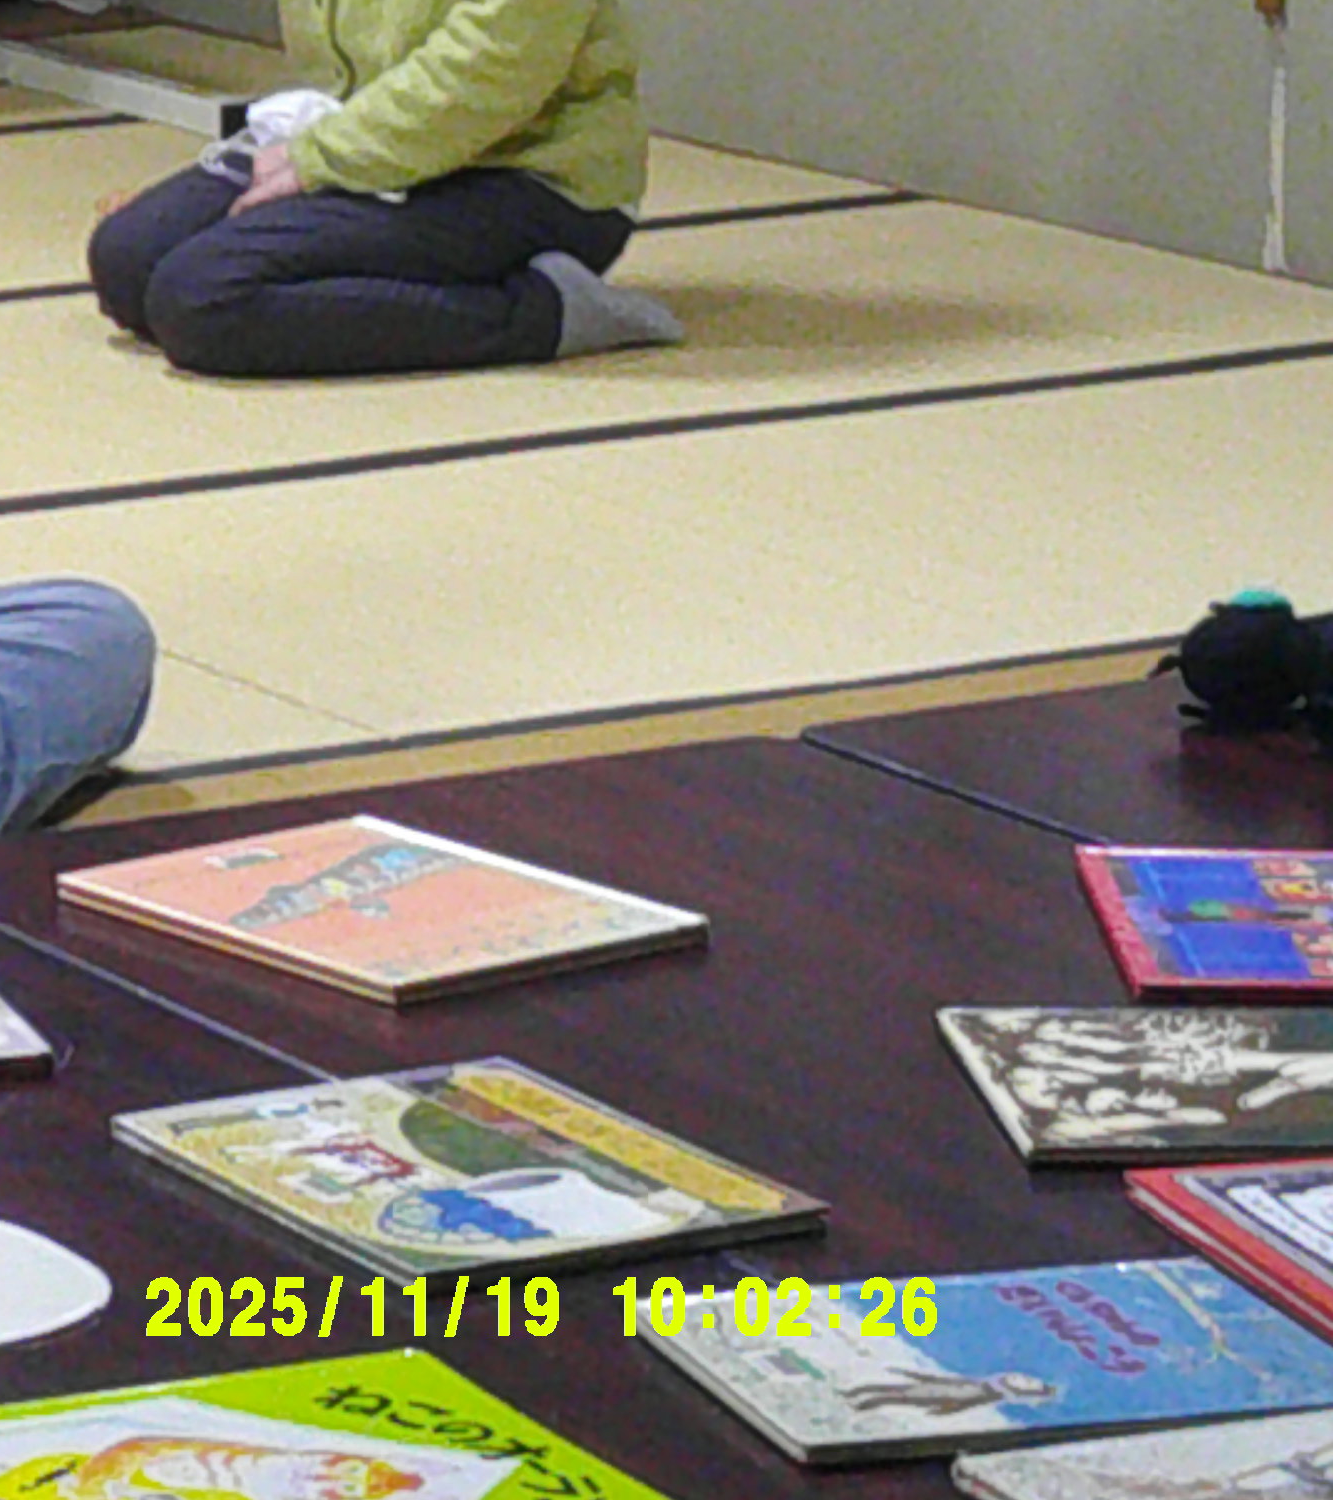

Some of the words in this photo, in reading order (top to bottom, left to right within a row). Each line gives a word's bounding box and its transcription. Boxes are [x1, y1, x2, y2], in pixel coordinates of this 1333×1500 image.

[314, 1385, 611, 1500] ねこのオーラ
